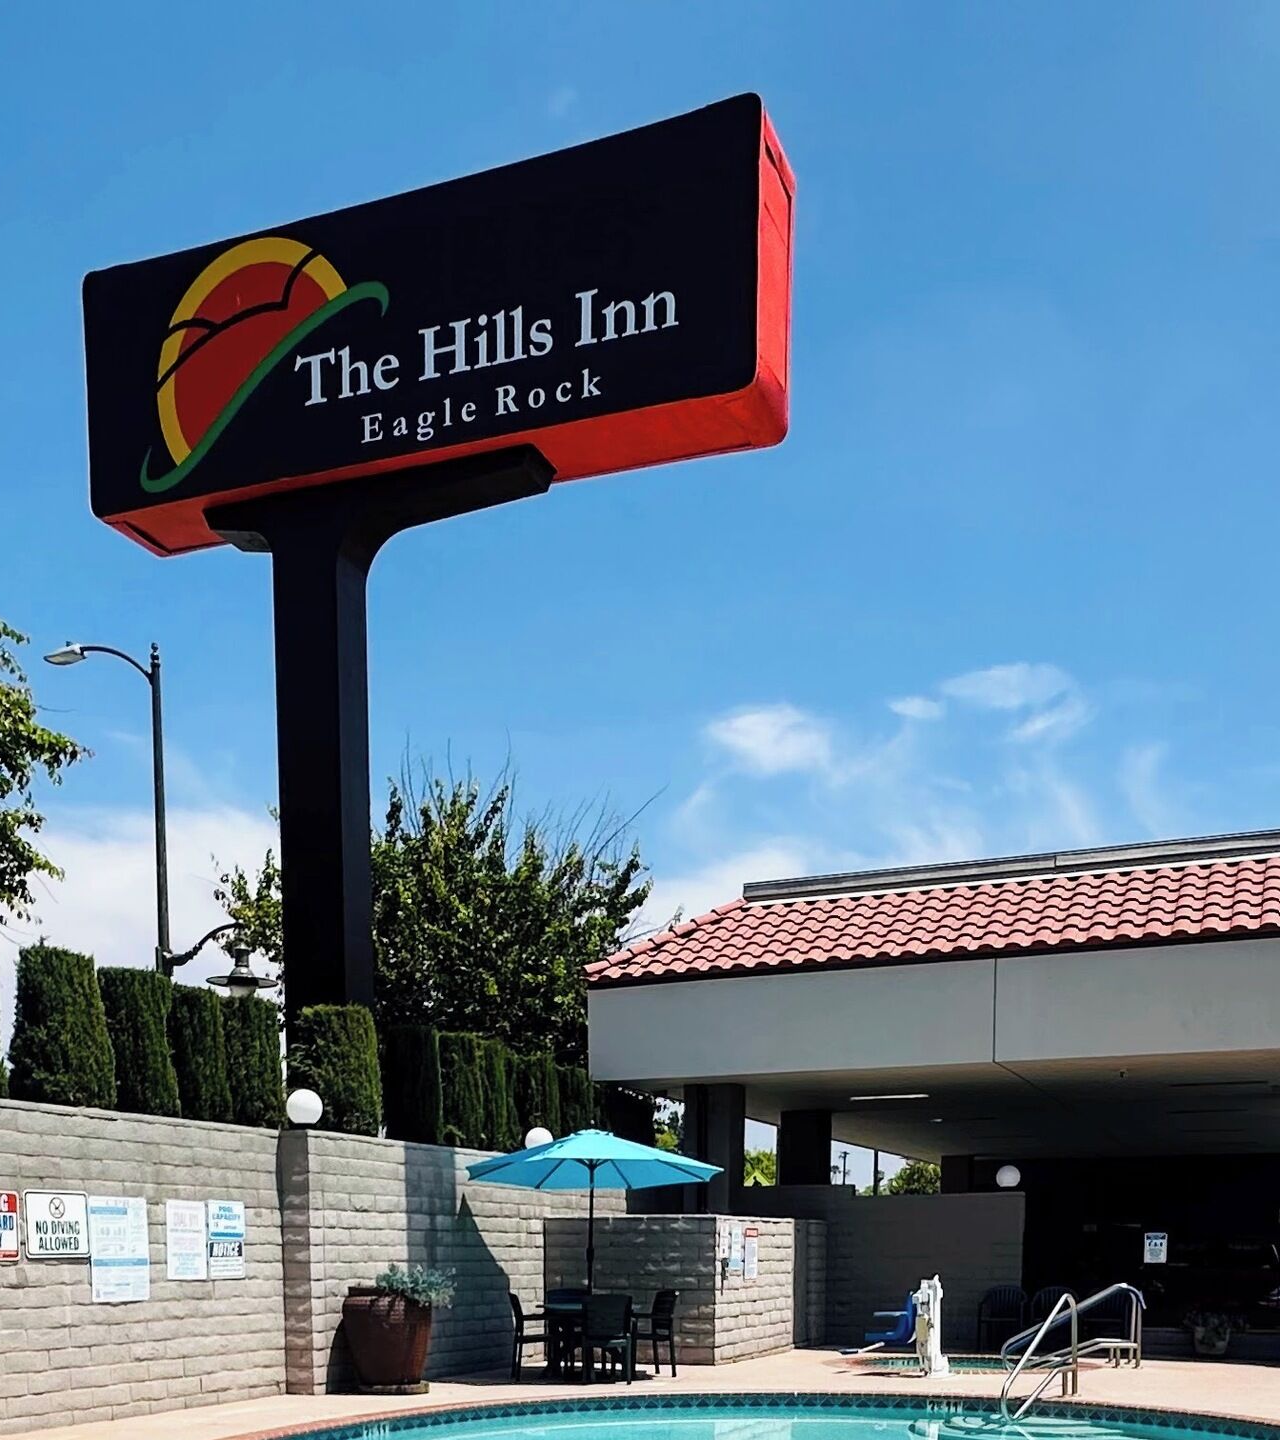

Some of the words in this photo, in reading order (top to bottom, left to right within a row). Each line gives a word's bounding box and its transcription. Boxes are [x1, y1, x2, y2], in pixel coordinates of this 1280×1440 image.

[294, 345, 400, 407] The
[418, 303, 554, 383] Hills
[574, 288, 680, 348] Inn
[360, 398, 477, 445] Eagle
[495, 367, 602, 416] Rock
[35, 1221, 48, 1235] NO
[51, 1221, 80, 1235] DIVING
[38, 1236, 80, 1251] ALLOWED
[212, 1242, 240, 1257] NOTICE
